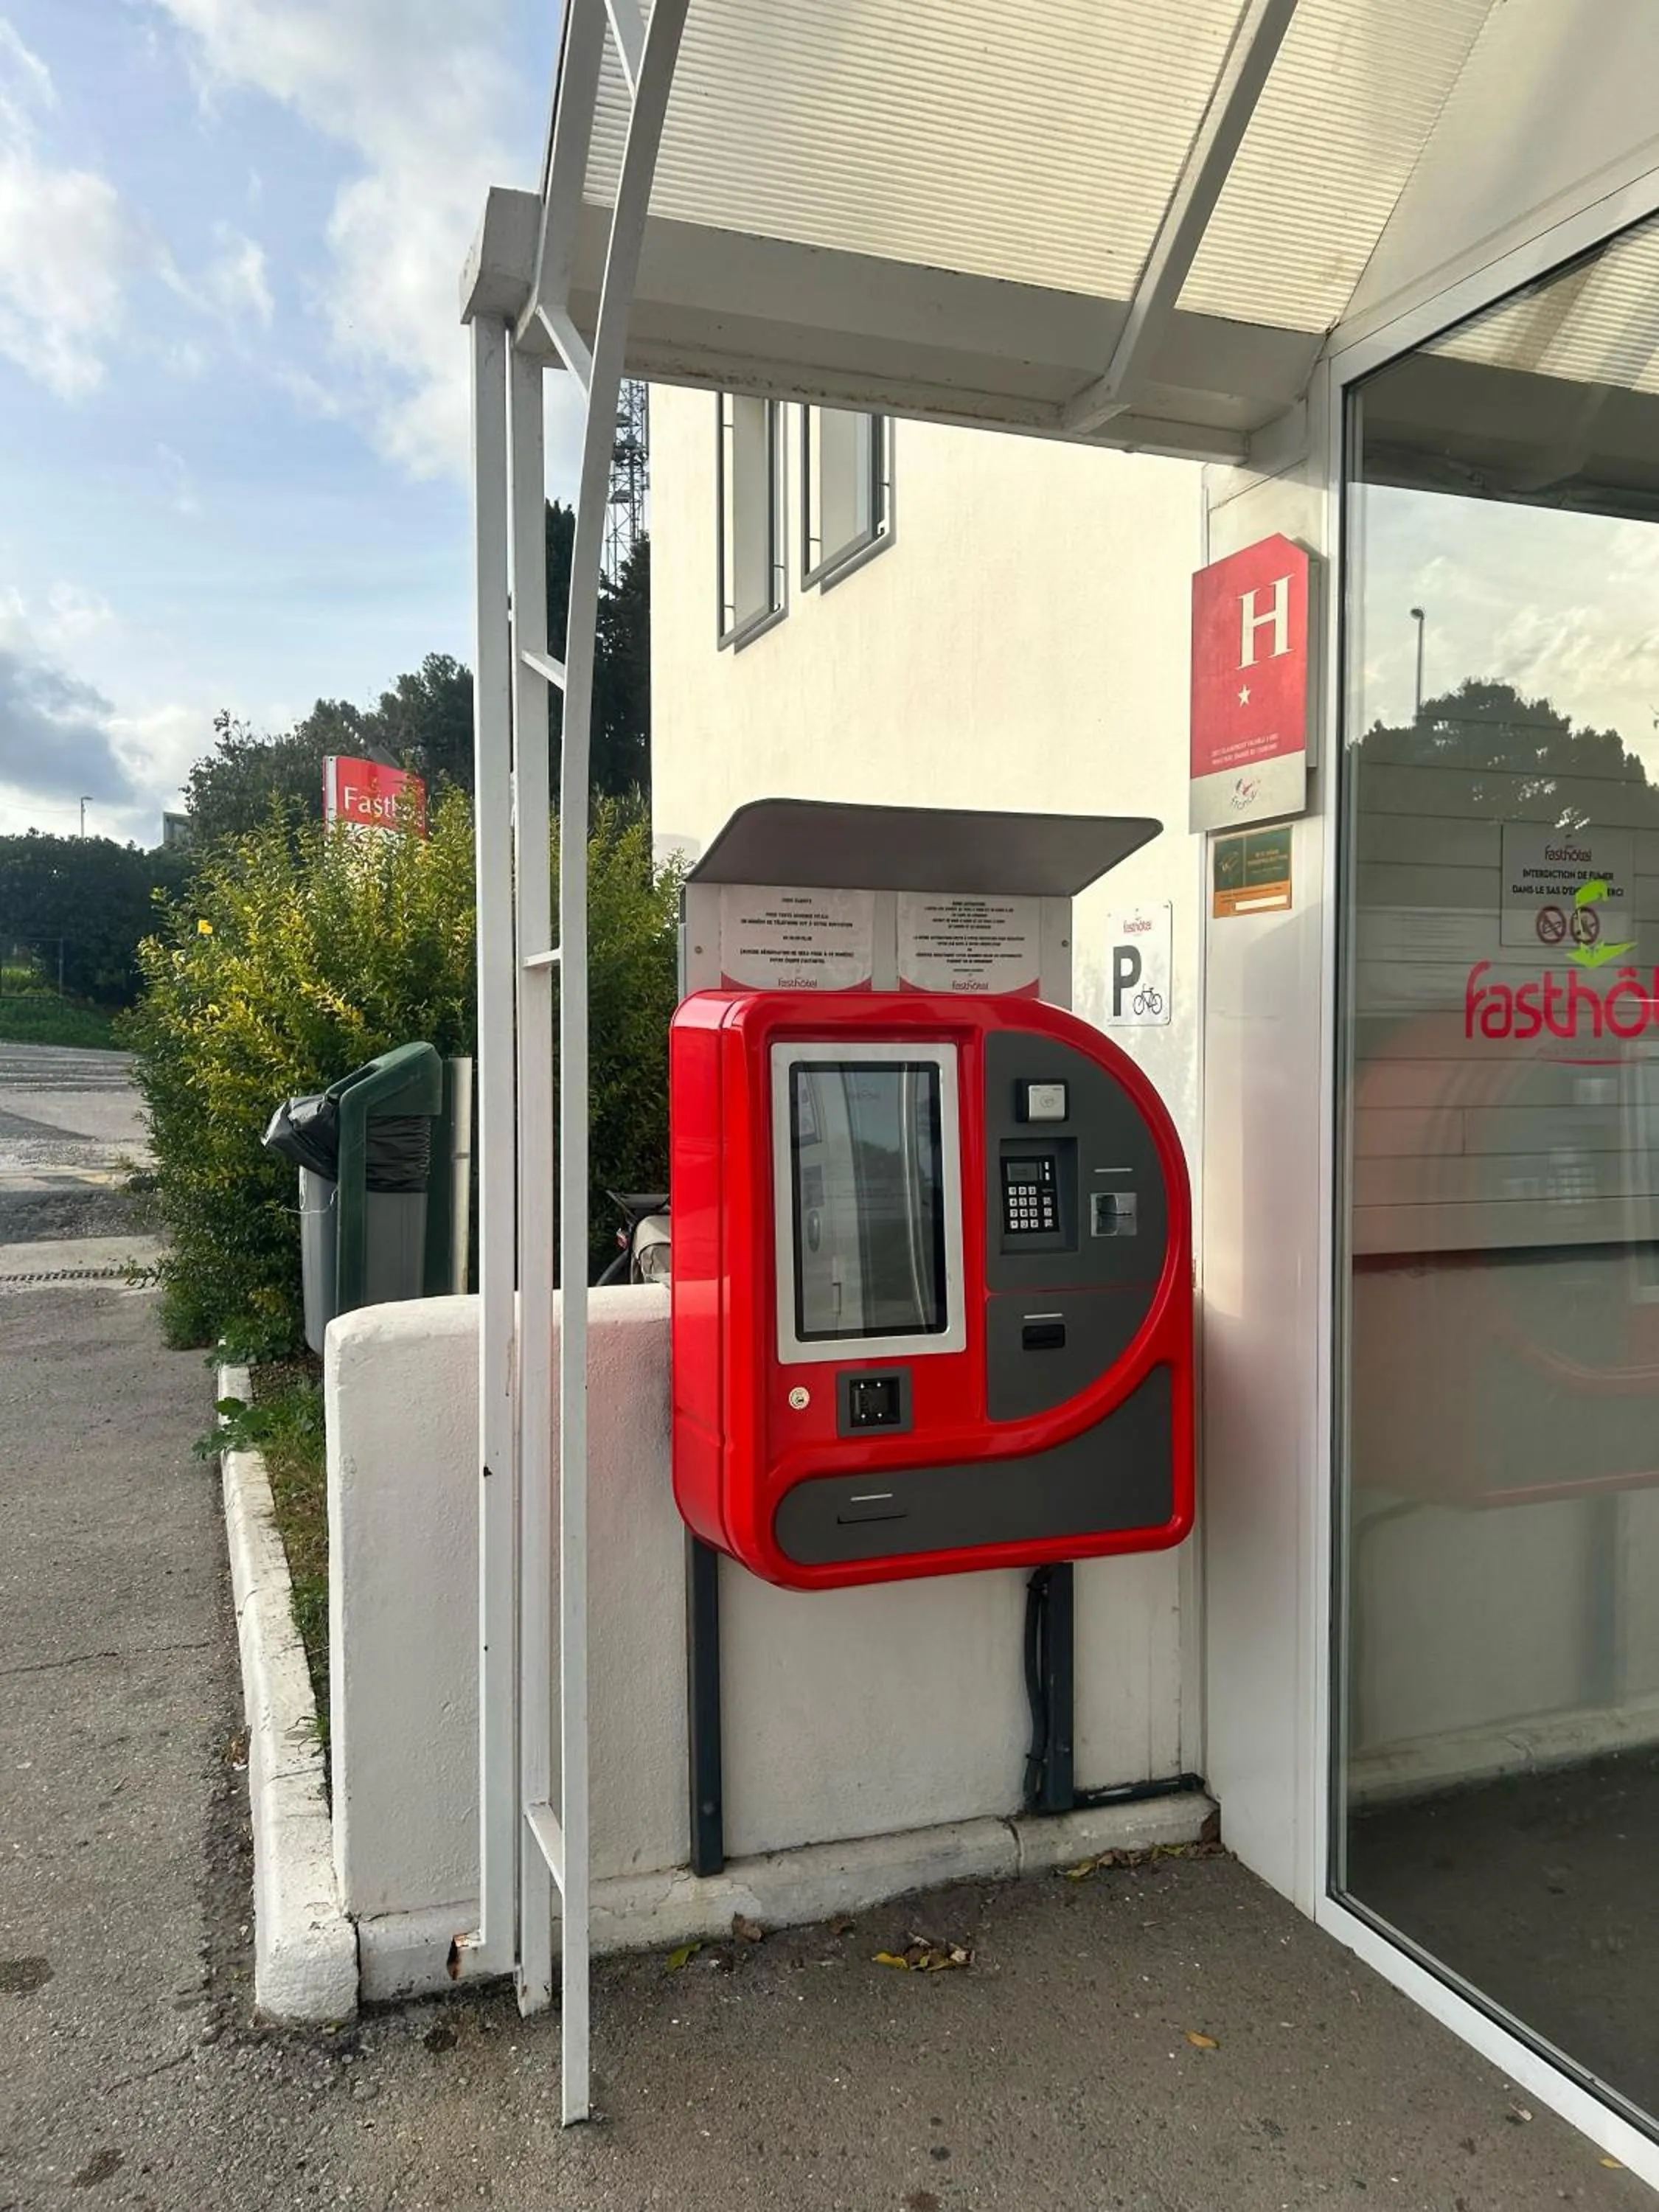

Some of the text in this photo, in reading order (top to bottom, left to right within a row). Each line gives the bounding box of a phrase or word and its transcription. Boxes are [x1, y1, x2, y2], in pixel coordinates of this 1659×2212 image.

[1237, 573, 1295, 670] H
[1113, 945, 1142, 1017] P
[1465, 959, 1659, 1040] fasthô
